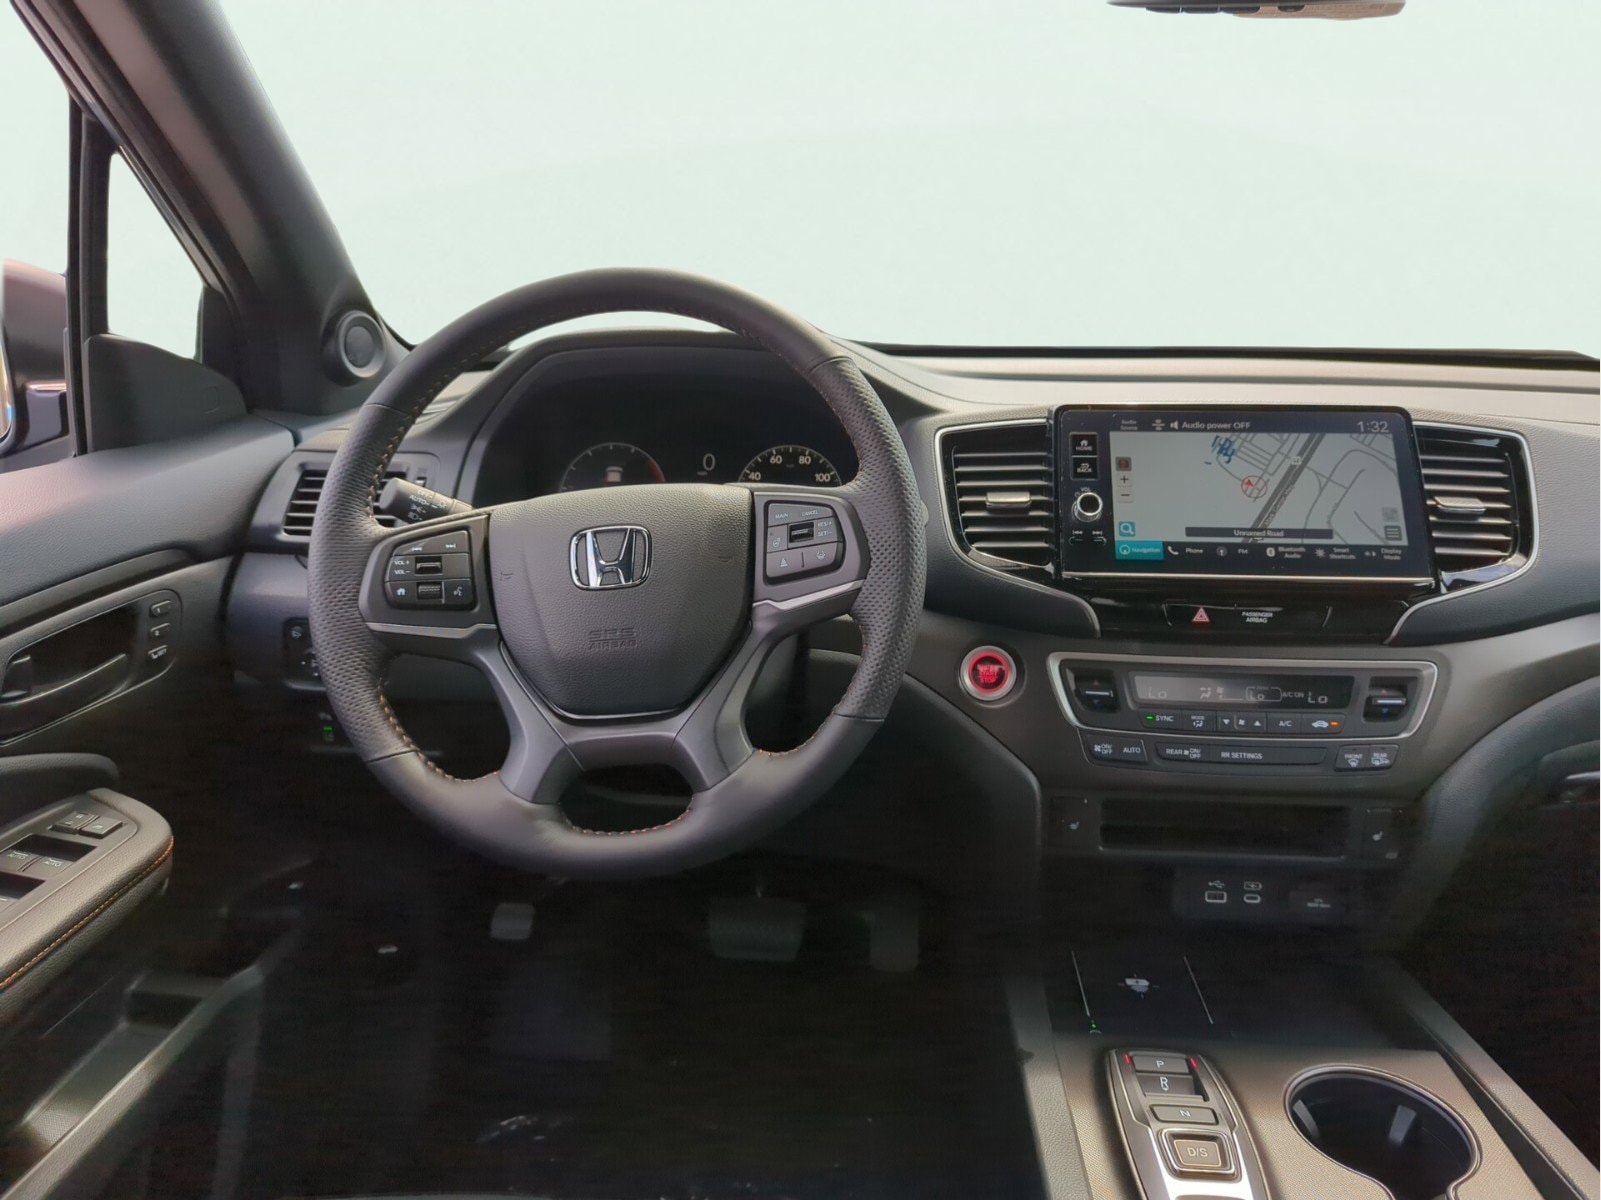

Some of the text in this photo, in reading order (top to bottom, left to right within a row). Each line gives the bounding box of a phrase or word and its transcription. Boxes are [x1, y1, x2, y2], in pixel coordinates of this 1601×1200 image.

[1182, 421, 1250, 432] Audio power OFF
[1357, 420, 1389, 433] 1:32
[702, 453, 716, 471] 0
[769, 455, 783, 465] 60
[798, 455, 812, 465] 80
[748, 471, 762, 481] 40
[814, 473, 831, 482] 100
[801, 509, 819, 517] CANCEL
[1233, 529, 1284, 538] Unnamed Road
[1155, 713, 1175, 722] SYNC
[1278, 719, 1292, 727] A/C
[1123, 746, 1141, 754] AUTO
[1166, 747, 1183, 755] REAR
[1231, 751, 1263, 760] SETTINGS
[1156, 1060, 1165, 1068] P
[1179, 1109, 1191, 1118] N
[1187, 1147, 1208, 1158] D/S
